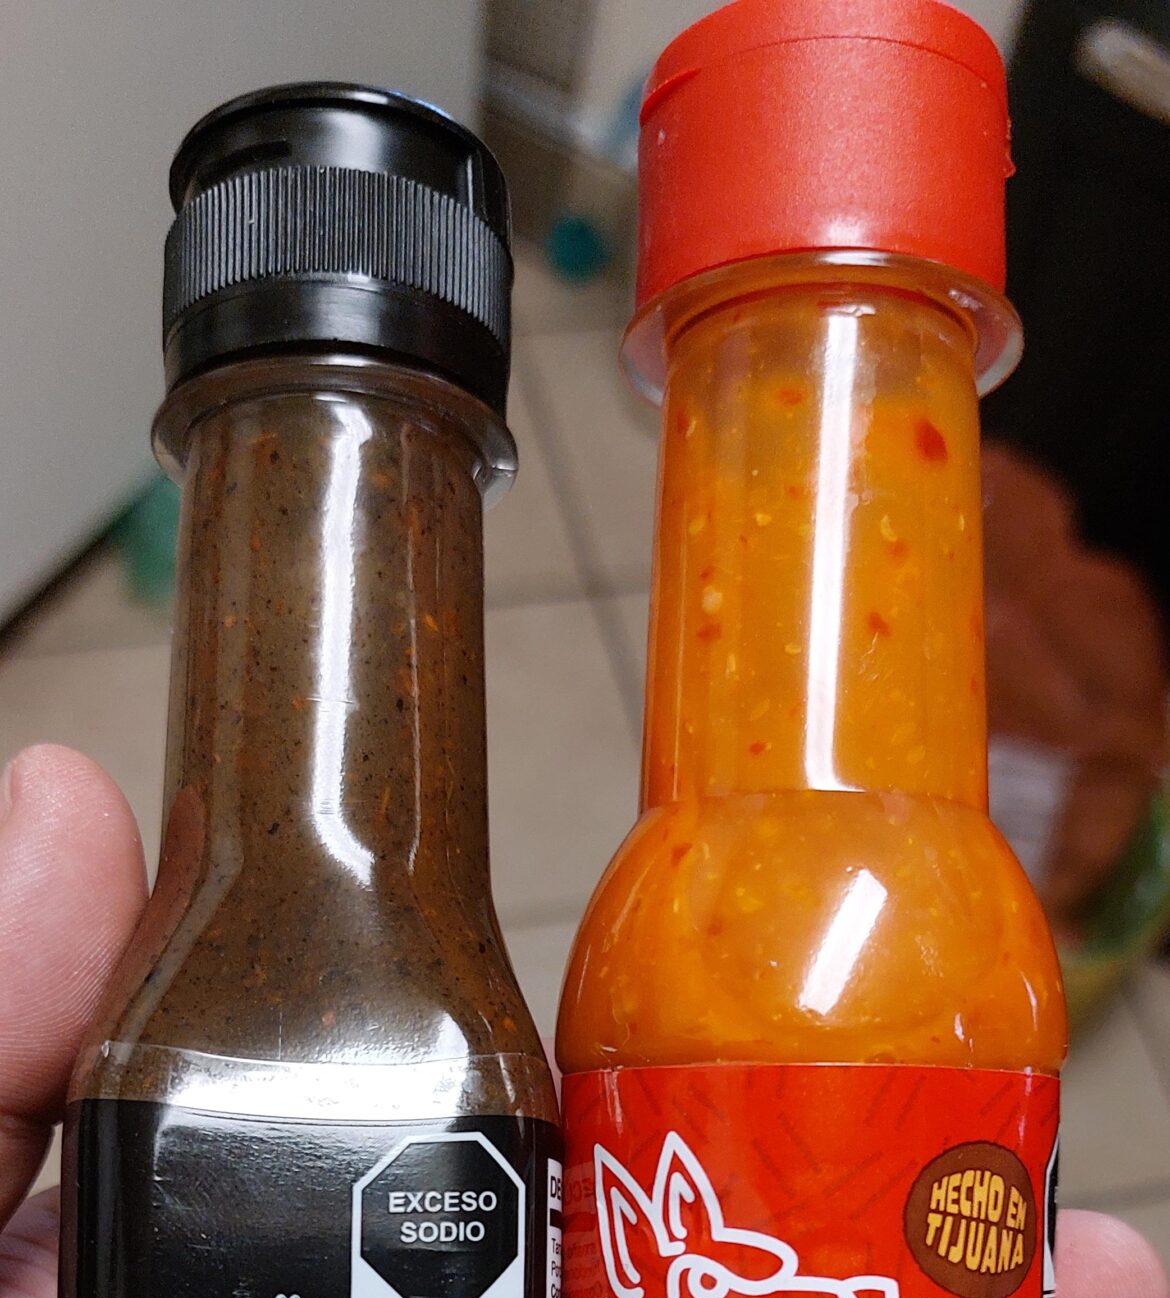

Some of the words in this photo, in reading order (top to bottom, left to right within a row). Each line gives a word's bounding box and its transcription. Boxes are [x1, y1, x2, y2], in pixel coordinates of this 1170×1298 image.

[388, 1190, 497, 1213] EXCESO
[930, 1169, 1005, 1223] HECHO
[1006, 1185, 1027, 1231] EN
[400, 1221, 485, 1243] SODIO
[925, 1212, 1024, 1274] TIJUANA
